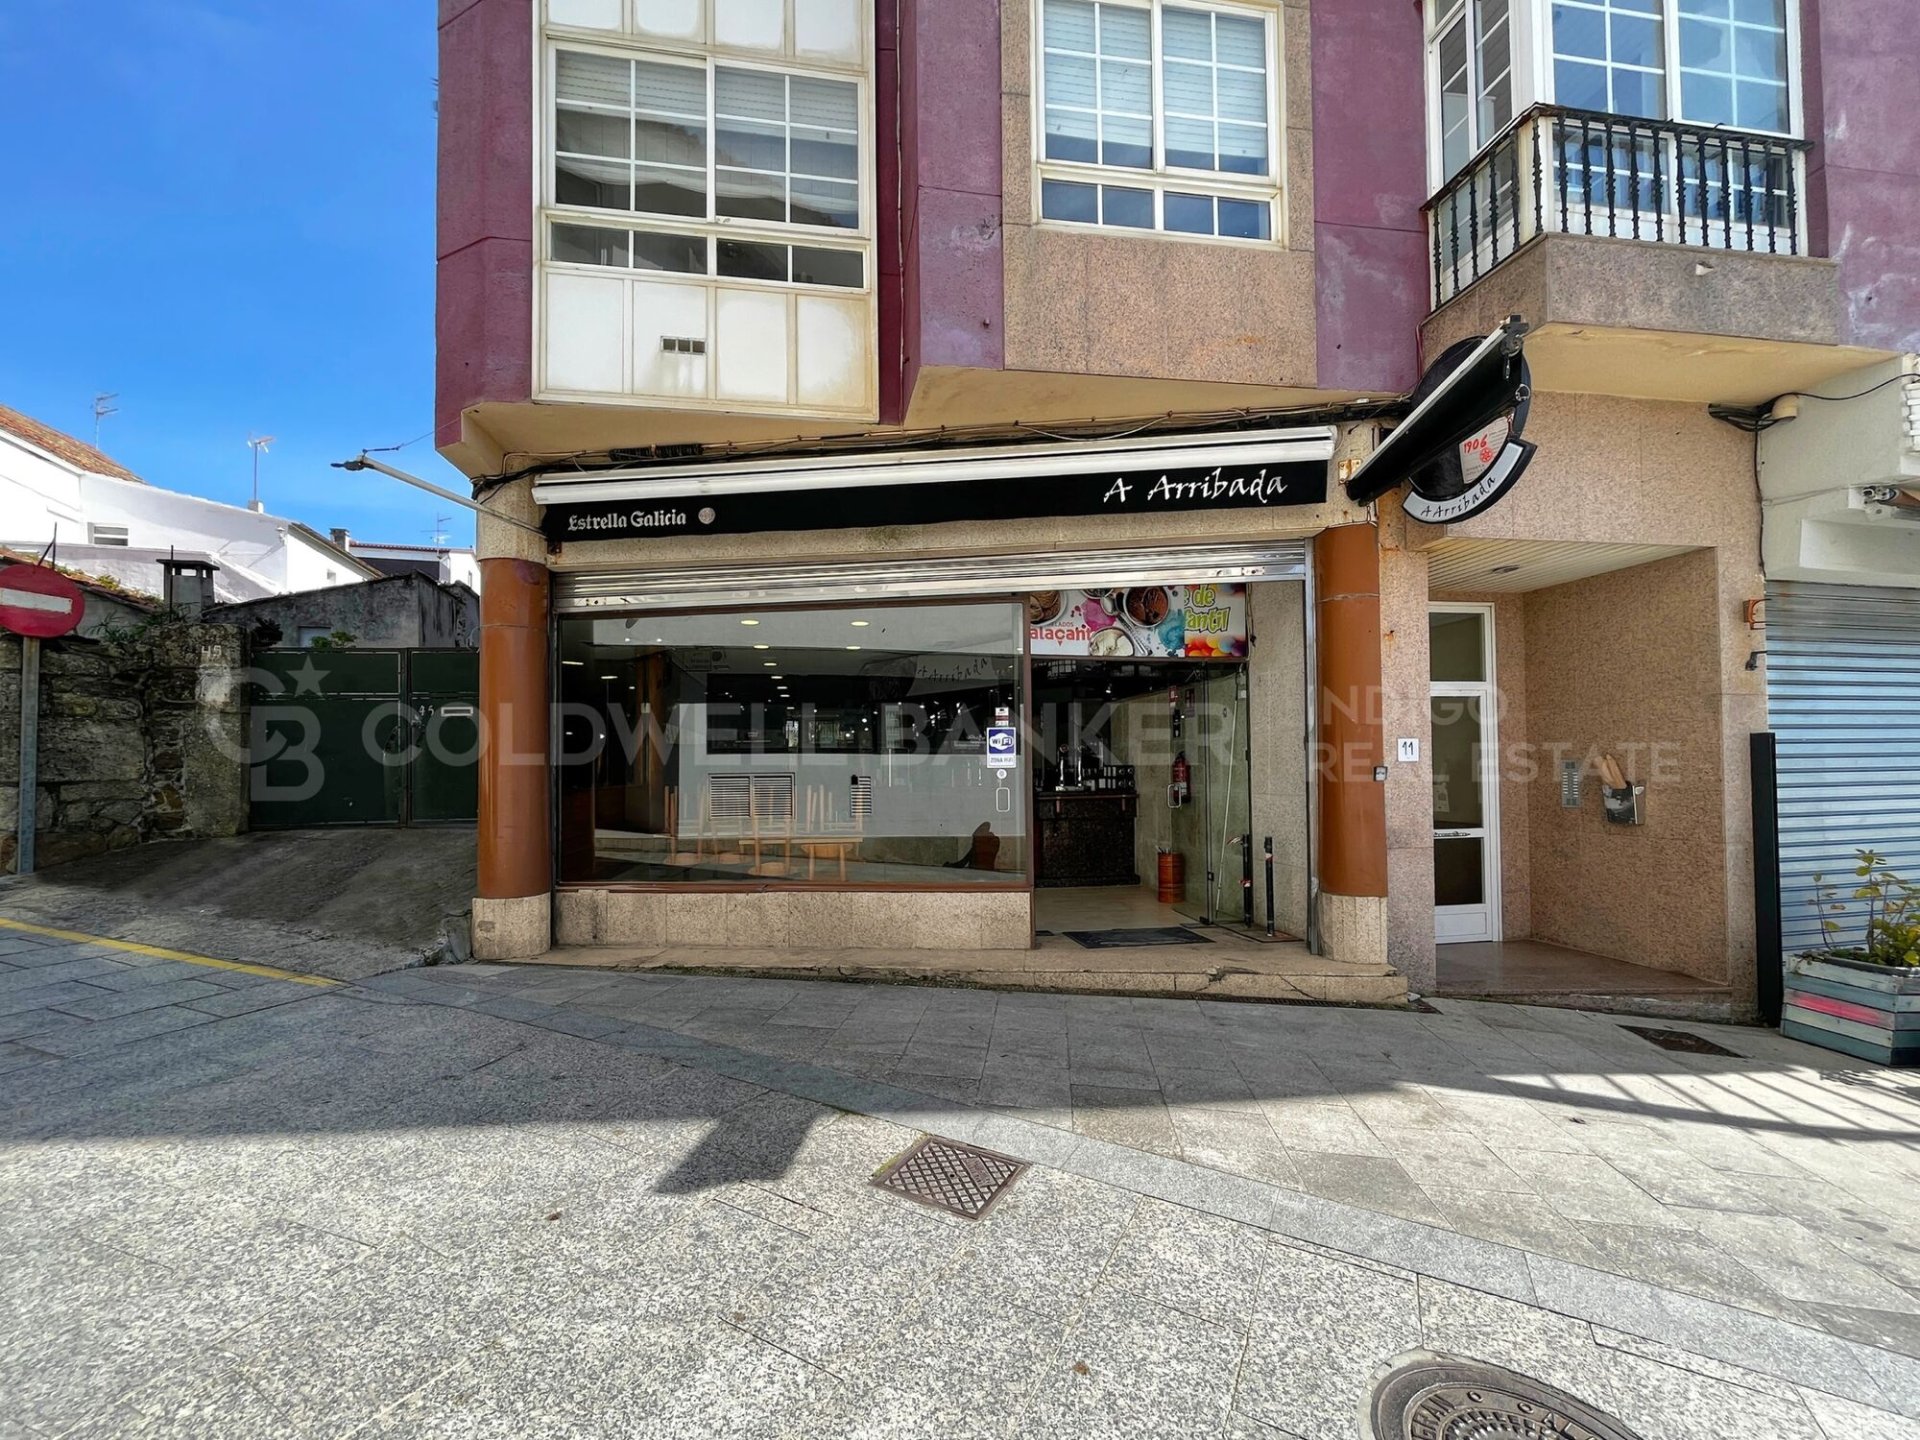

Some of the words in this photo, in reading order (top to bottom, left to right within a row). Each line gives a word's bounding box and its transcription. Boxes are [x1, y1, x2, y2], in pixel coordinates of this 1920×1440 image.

[1464, 434, 1487, 453] 1906
[1104, 478, 1133, 502] A
[1147, 467, 1288, 503] Arribada
[1421, 505, 1431, 517] A
[1433, 476, 1495, 517] Arribada
[567, 513, 627, 531] Estrella
[630, 509, 687, 527] Galicia
[201, 645, 222, 658] 45
[1402, 741, 1414, 756] 11
